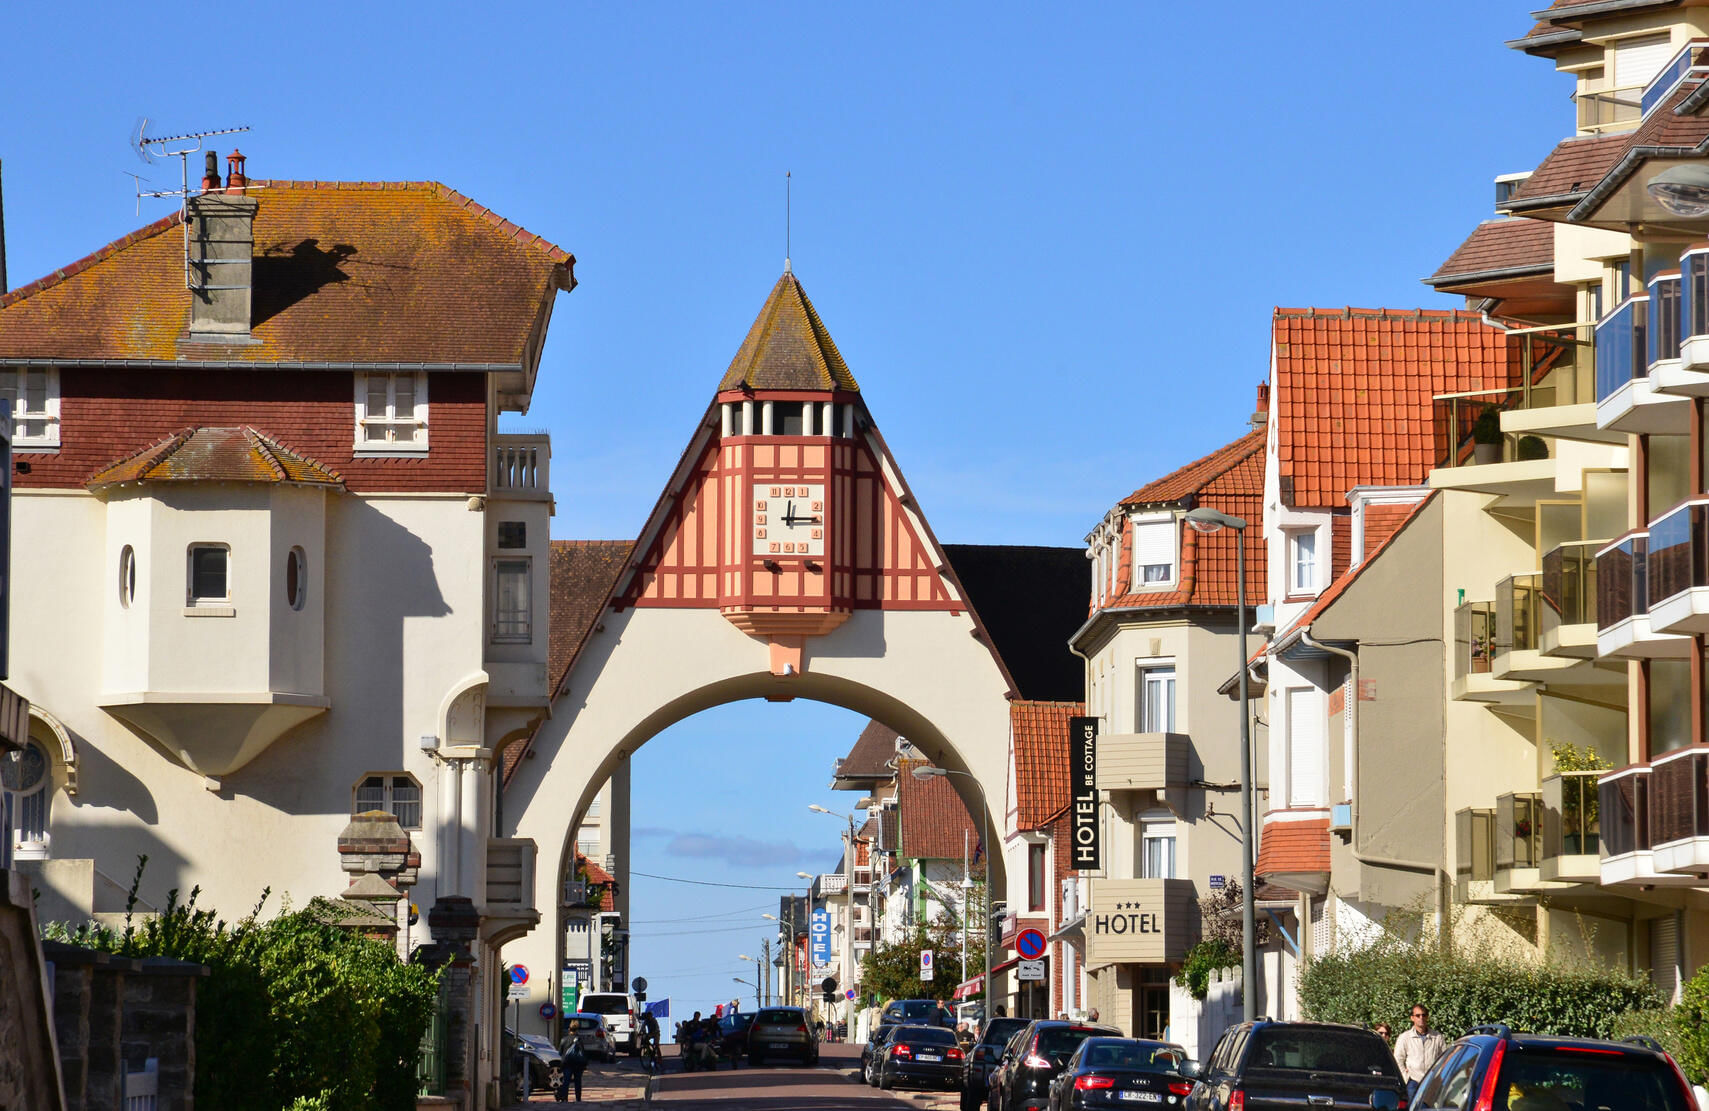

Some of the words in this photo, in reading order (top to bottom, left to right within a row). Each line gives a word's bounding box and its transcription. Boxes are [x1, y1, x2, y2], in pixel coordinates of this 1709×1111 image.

[1085, 725, 1093, 771] COTTAGE
[1085, 774, 1093, 786] BE
[1077, 791, 1094, 861] HOTEL
[813, 913, 827, 962] HOTEL
[1096, 914, 1161, 934] HOTEL
